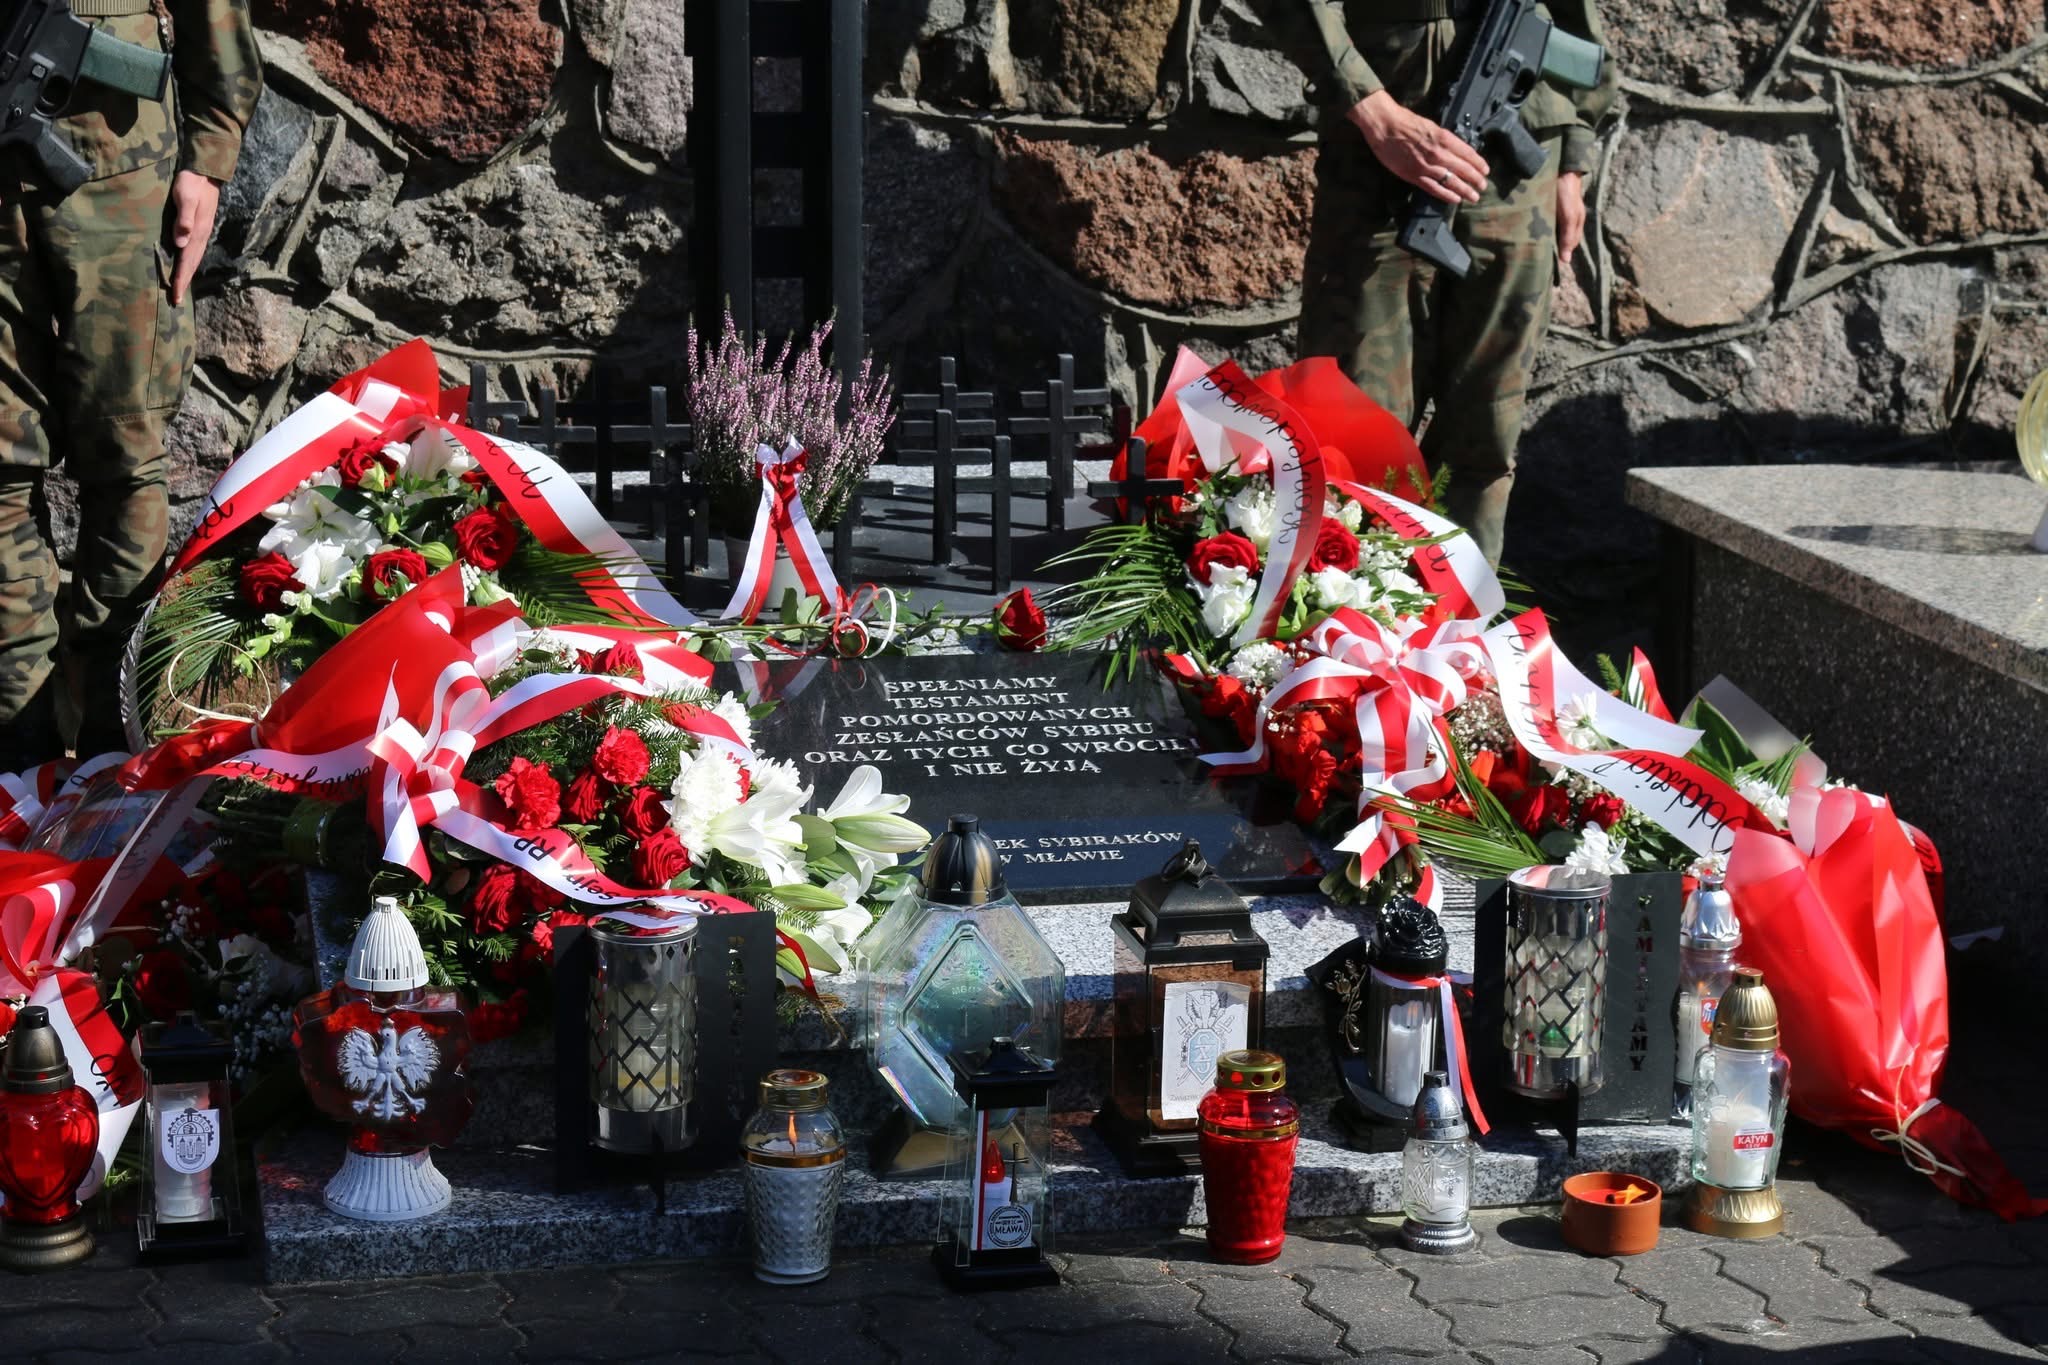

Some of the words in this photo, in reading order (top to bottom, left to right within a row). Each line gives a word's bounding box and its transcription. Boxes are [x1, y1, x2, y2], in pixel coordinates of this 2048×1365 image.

[883, 676, 1057, 693] SPEŁNIAMY
[887, 692, 1069, 709] TESTAMENT
[840, 706, 1135, 728] POMORDOWANYCH
[835, 725, 1028, 745] ZESŁAŃCÓW
[1043, 722, 1154, 738] SYBIRU
[804, 749, 893, 764] ORAZ
[904, 745, 994, 760] TYCH
[1006, 743, 1050, 756] CO
[1061, 737, 1200, 754] WRÓCILI
[923, 764, 940, 777] I
[950, 762, 1007, 776] NIE
[1020, 758, 1102, 774] ŻYJĄ
[513, 834, 557, 862] RP
[1038, 831, 1183, 848] SYBIRAKÓW
[1025, 850, 1124, 864] MŁAWIE
